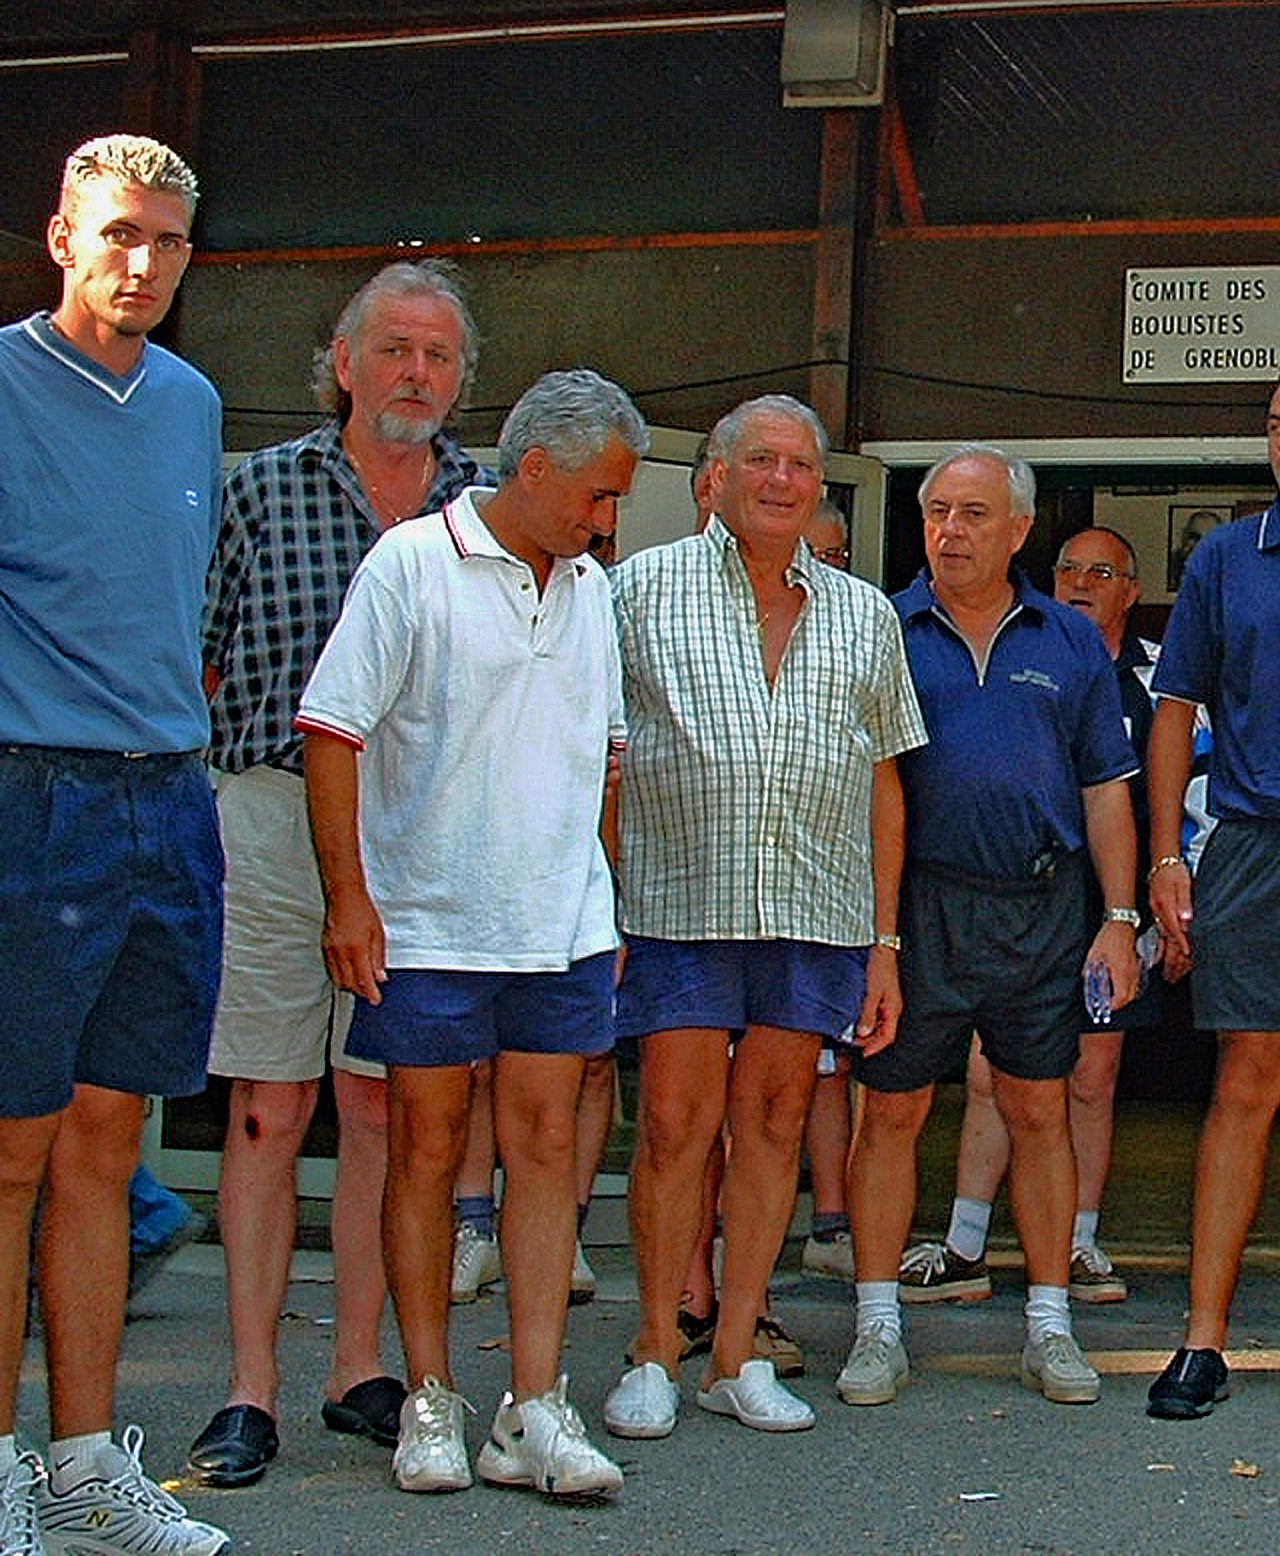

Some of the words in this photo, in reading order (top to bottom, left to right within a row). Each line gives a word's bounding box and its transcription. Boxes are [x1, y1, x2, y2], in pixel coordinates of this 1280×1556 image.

[1132, 281, 1209, 302] COMITE
[1227, 280, 1265, 300] DES
[1132, 314, 1243, 336] BOULISTES
[1131, 350, 1155, 369] DE
[86, 1510, 109, 1527] N
